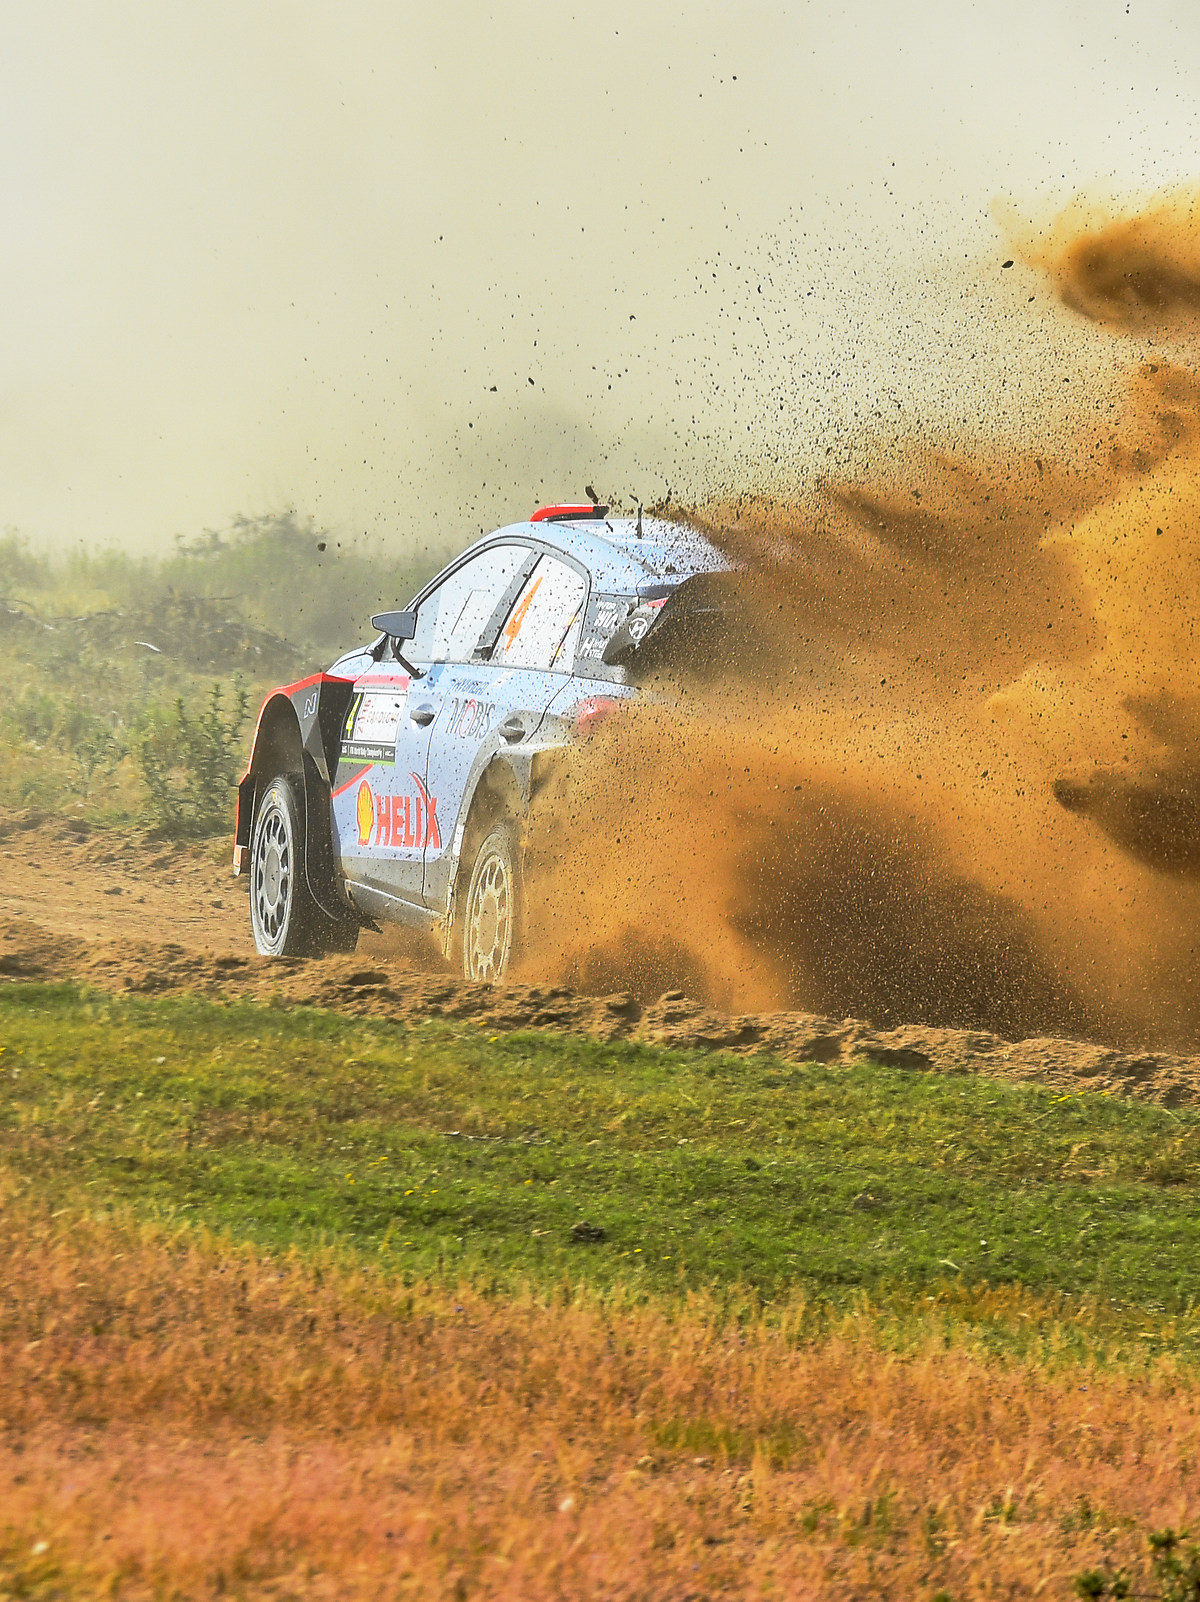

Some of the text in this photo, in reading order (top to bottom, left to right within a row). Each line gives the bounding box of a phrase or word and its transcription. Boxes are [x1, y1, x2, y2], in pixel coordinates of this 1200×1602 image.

[504, 576, 543, 652] 4
[345, 693, 362, 739] 4
[445, 697, 496, 739] MOBIS
[375, 782, 443, 849] HELIX
